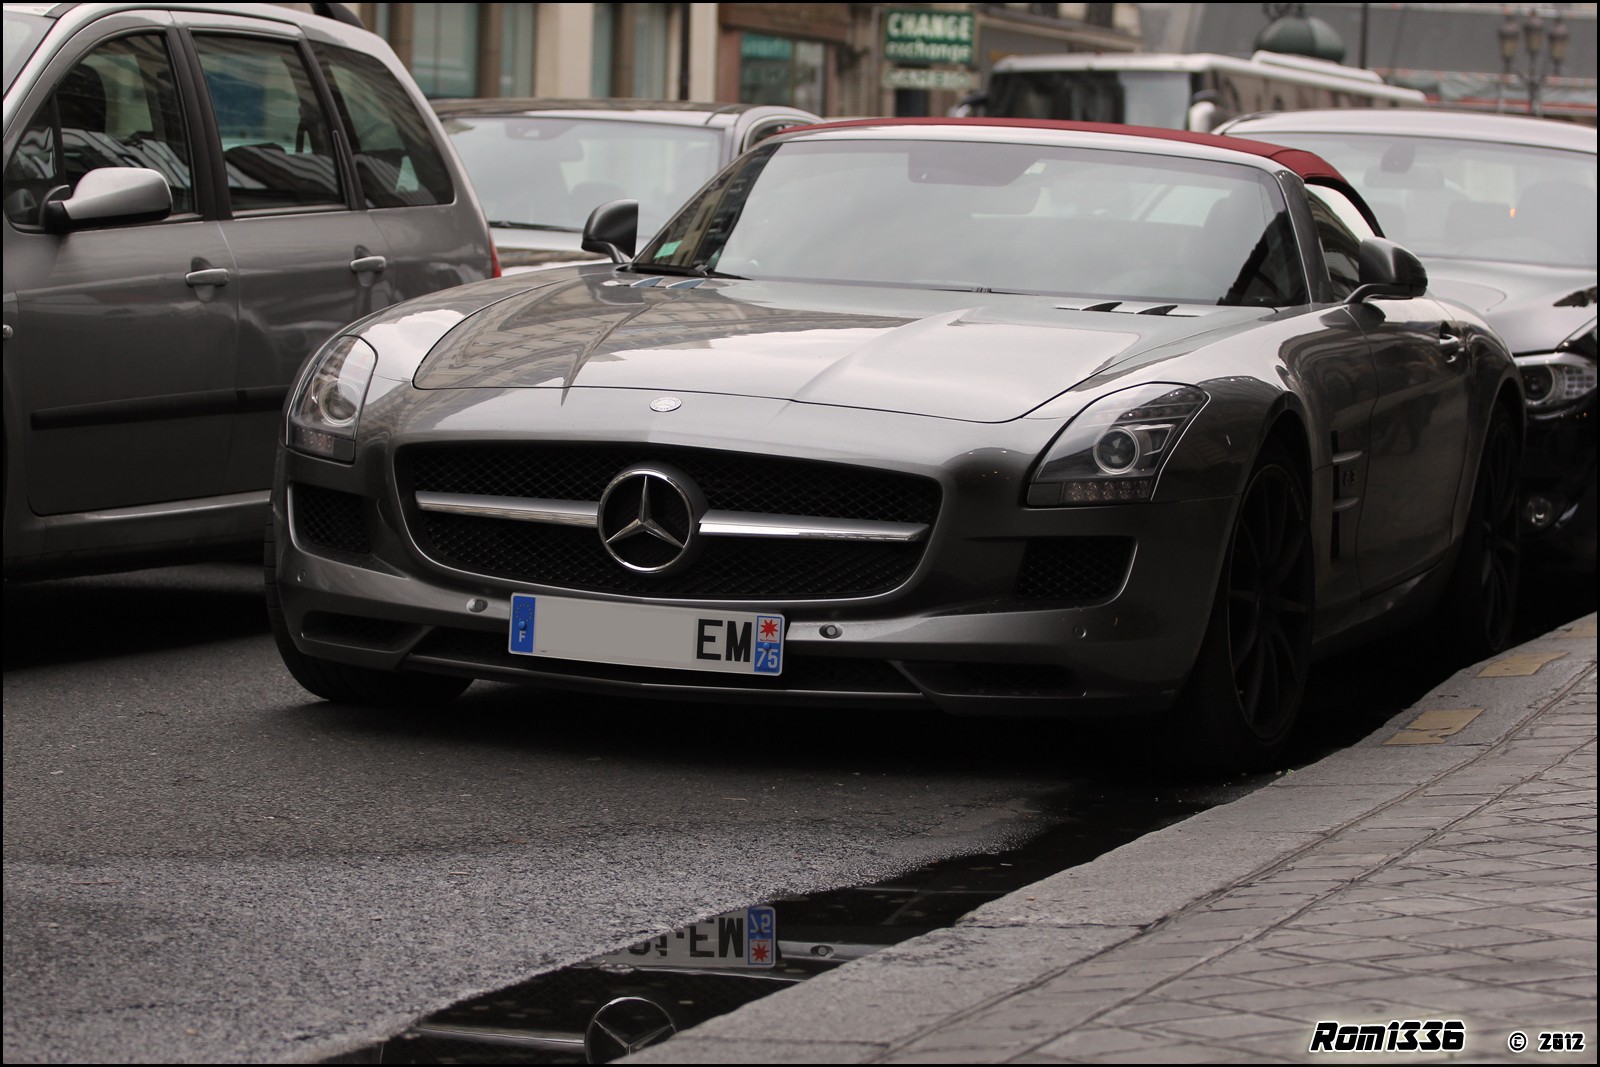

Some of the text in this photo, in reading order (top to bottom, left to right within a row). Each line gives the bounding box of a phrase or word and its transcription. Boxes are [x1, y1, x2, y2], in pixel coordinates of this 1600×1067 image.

[887, 12, 972, 40] CHANGE
[886, 40, 972, 62] exchange
[518, 630, 526, 643] F
[696, 618, 753, 663] EM
[756, 647, 779, 669] 75
